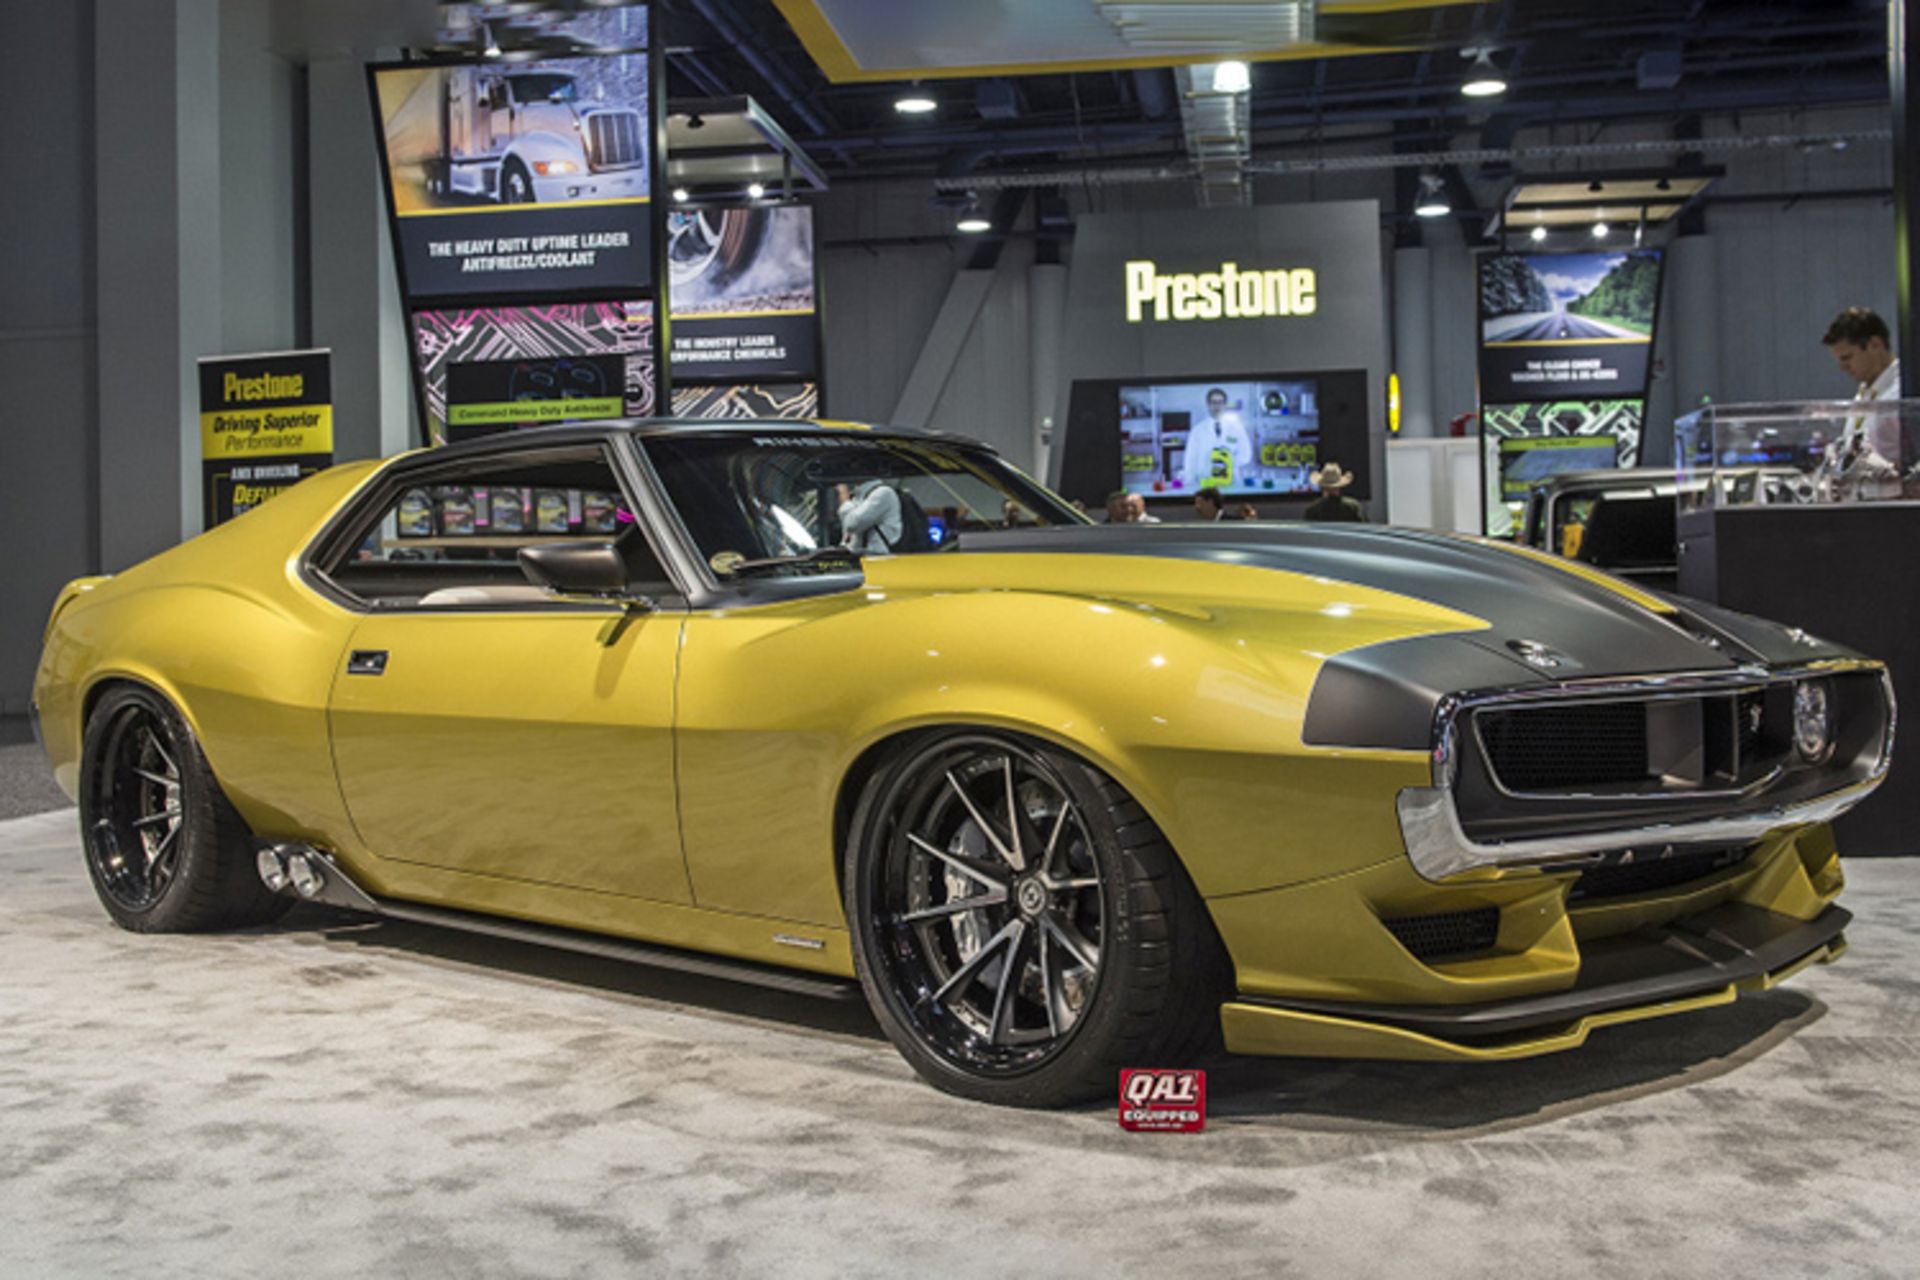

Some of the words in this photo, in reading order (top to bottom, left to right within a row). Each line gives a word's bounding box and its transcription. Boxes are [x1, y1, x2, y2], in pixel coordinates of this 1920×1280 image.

[428, 242, 451, 256] THE
[455, 239, 493, 254] HEAVY
[497, 237, 528, 252] DUTY
[532, 234, 577, 250] UPTIME
[581, 232, 629, 247] LEADER
[461, 250, 595, 272] ANTIFREEZE/COOLANT
[1125, 260, 1317, 322] Prestone
[674, 338, 691, 350] THE
[694, 337, 737, 349] INDUSTRY
[223, 372, 304, 402] Prestone
[213, 415, 261, 435] Driving
[263, 411, 320, 432] Superior
[459, 408, 507, 419] Command
[510, 406, 538, 417] Heavy
[540, 405, 562, 416] Duty
[224, 434, 304, 451] Performance
[1126, 1074, 1195, 1106] QA1
[1123, 1110, 1199, 1122] EQUIPPED
